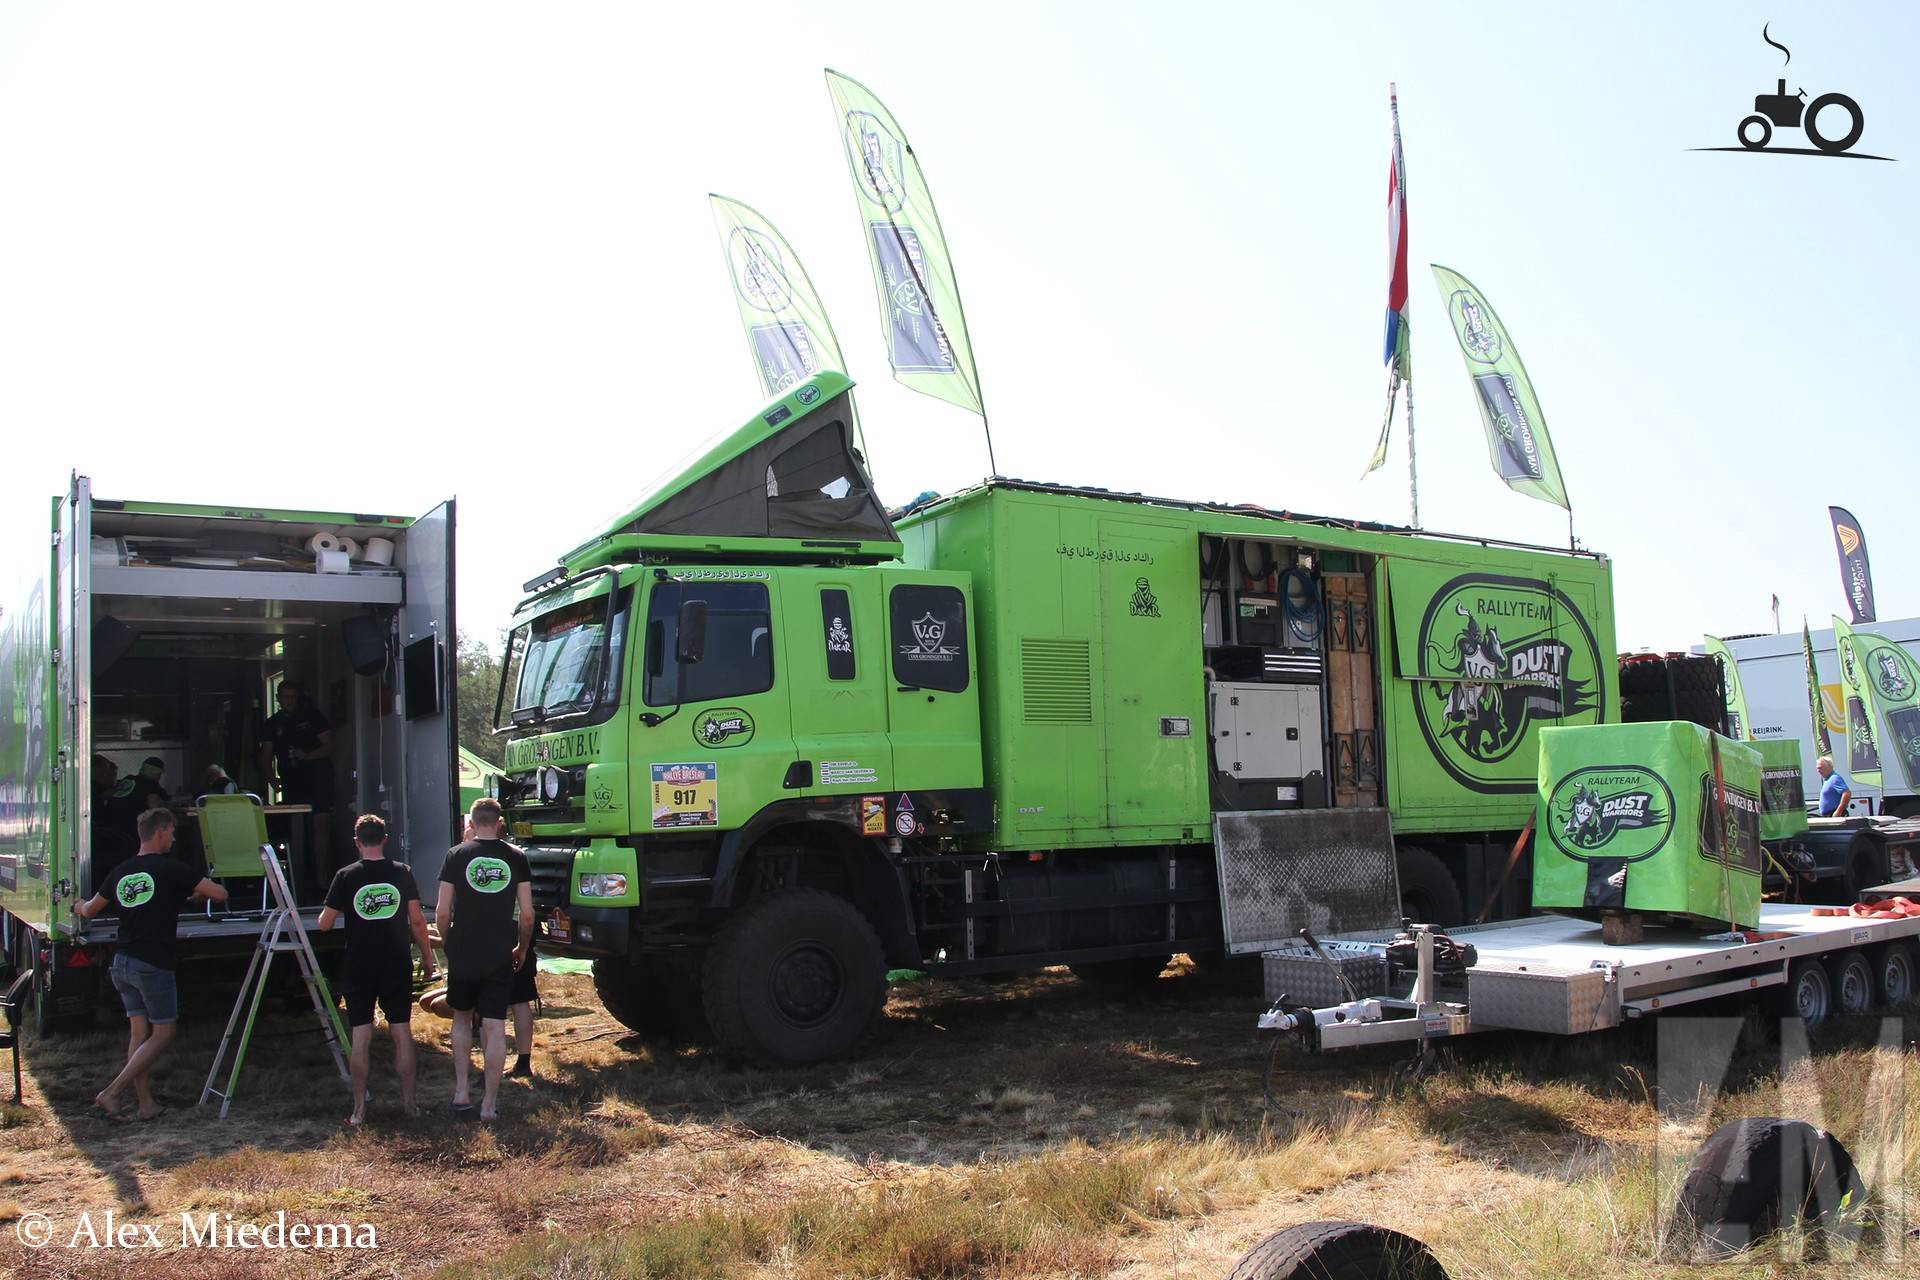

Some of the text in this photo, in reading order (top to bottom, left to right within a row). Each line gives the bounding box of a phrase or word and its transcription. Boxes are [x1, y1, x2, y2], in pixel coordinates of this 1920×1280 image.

[576, 731, 601, 757] B.V.
[1587, 776, 1640, 786] RALLYTEAM
[673, 789, 696, 805] 917
[1603, 795, 1648, 812] DUST
[1602, 807, 1644, 818] WARRIORS
